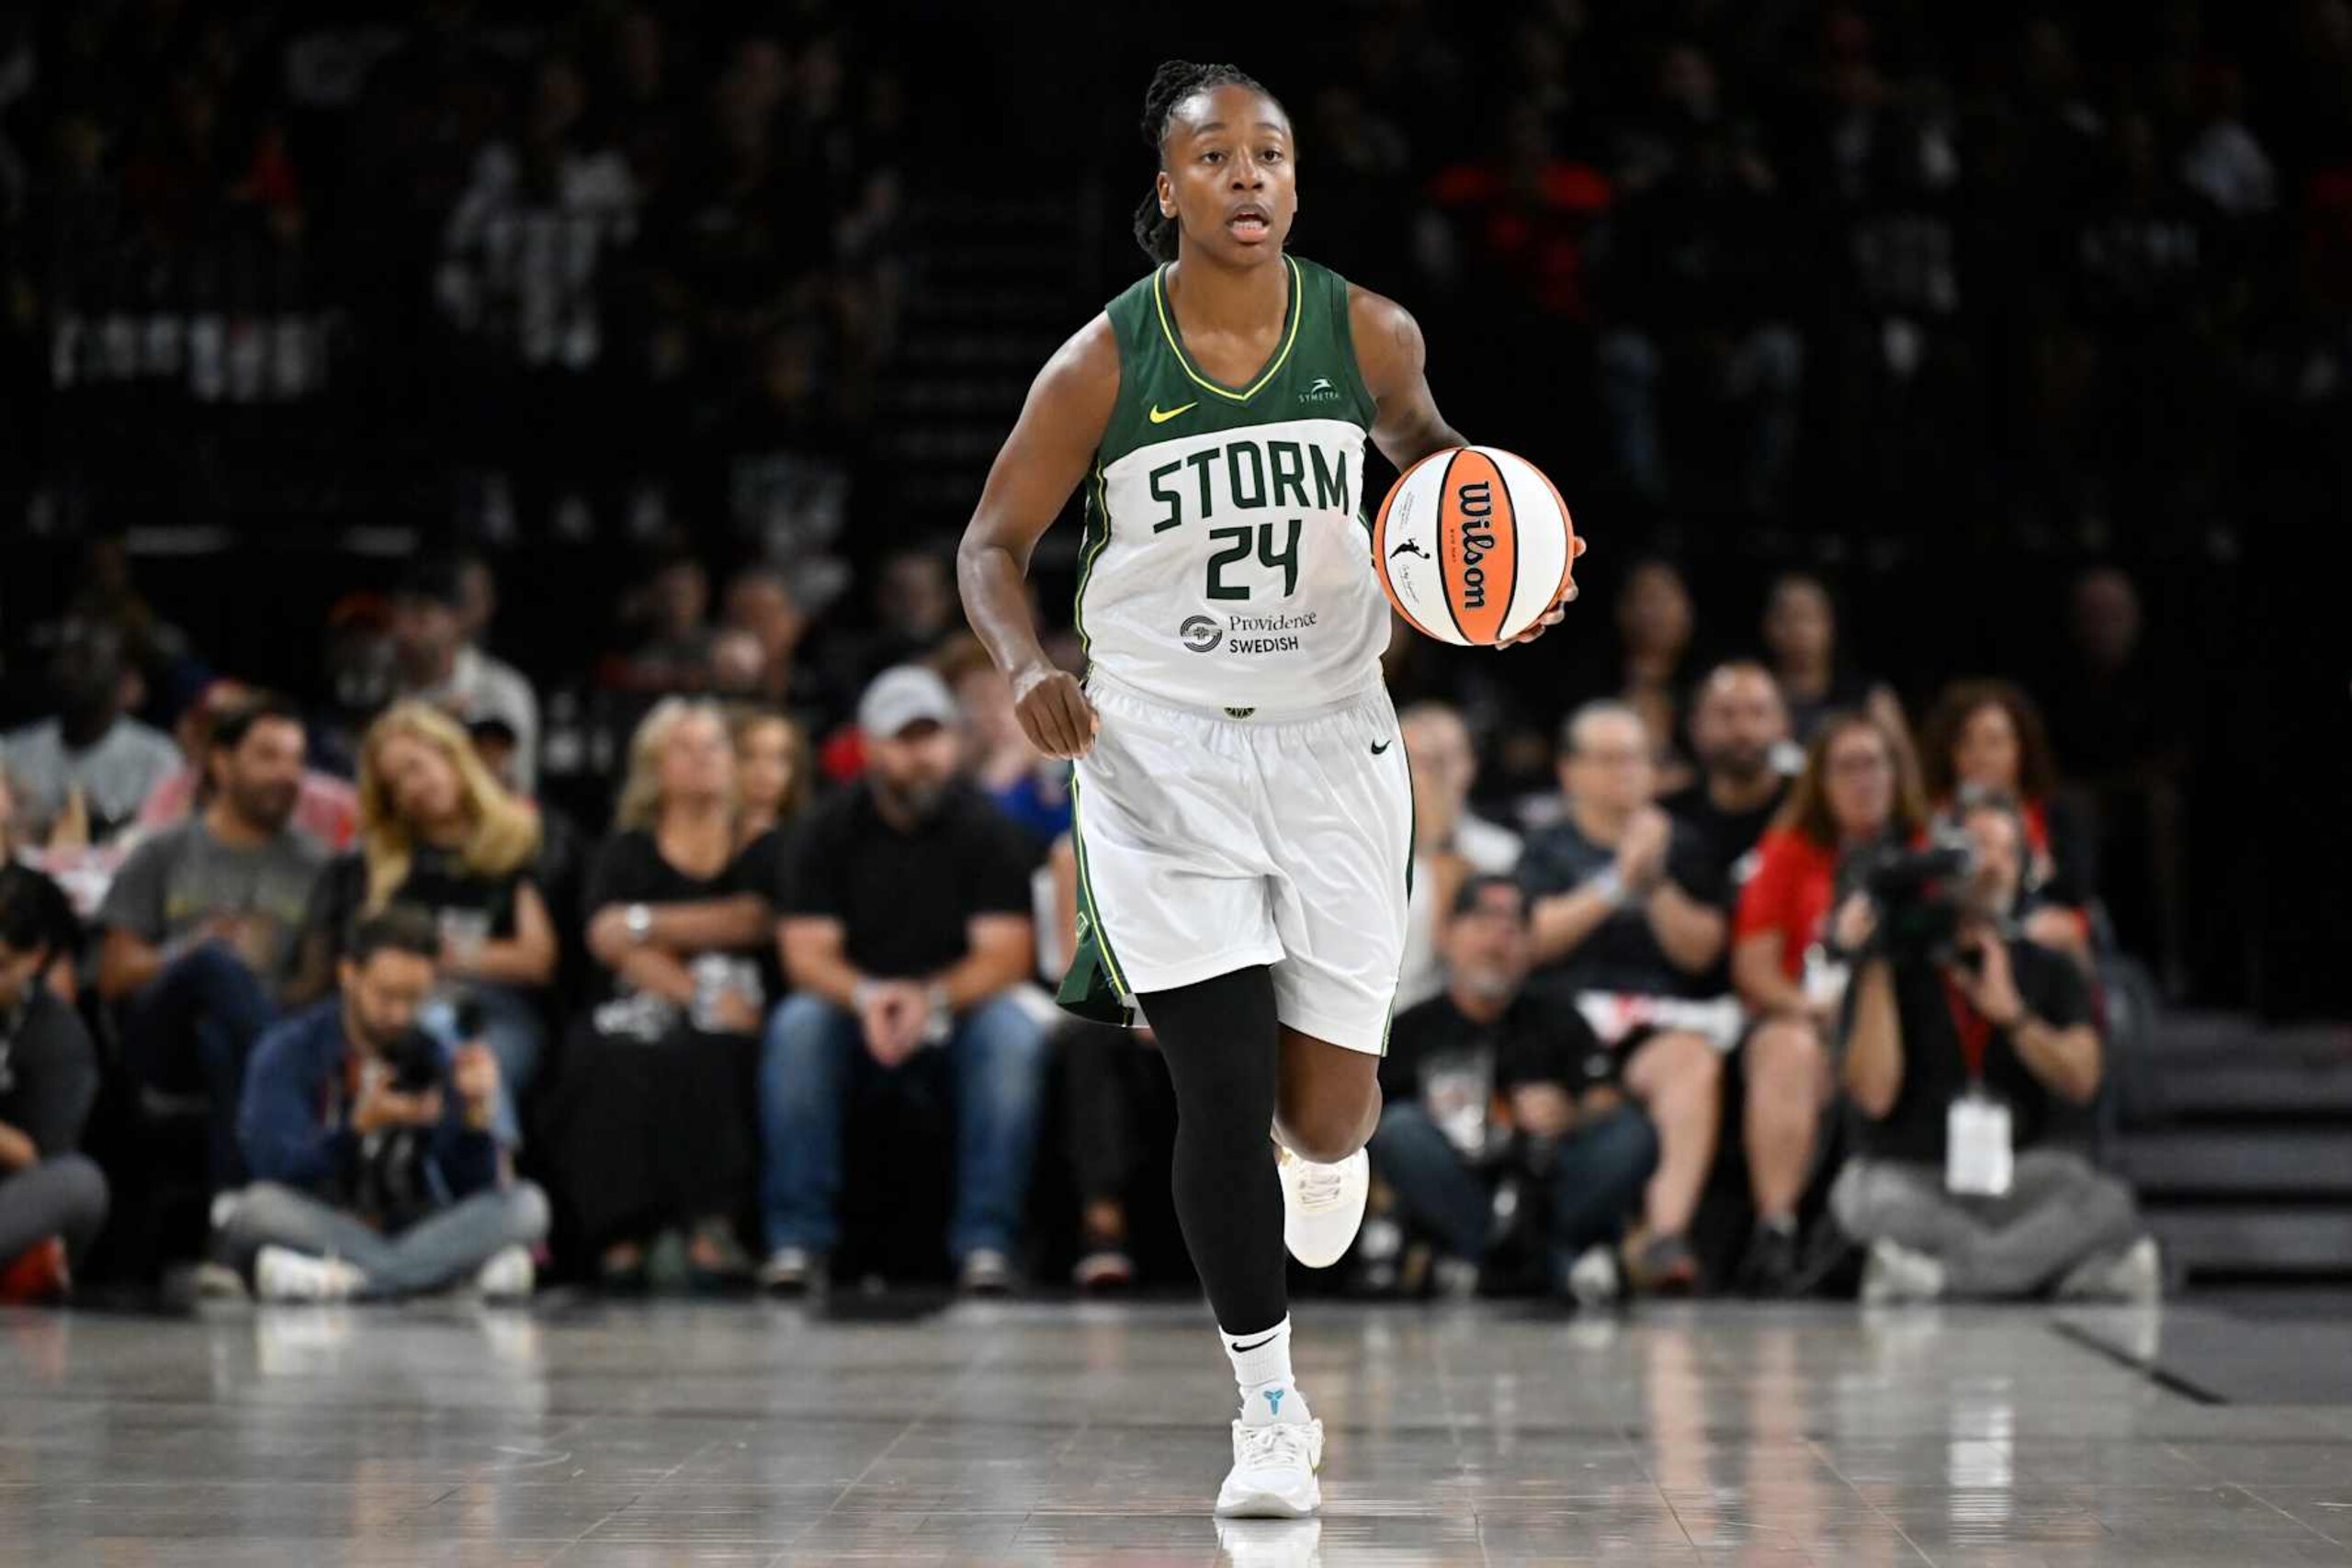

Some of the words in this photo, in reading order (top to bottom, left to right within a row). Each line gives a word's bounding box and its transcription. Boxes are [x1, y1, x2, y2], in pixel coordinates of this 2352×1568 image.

[1149, 440, 1349, 534] STORM
[1206, 519, 1302, 600] 24
[1458, 480, 1495, 610] Wilson
[1229, 612, 1317, 631] Providence
[1229, 636, 1299, 654] SWEDISH
